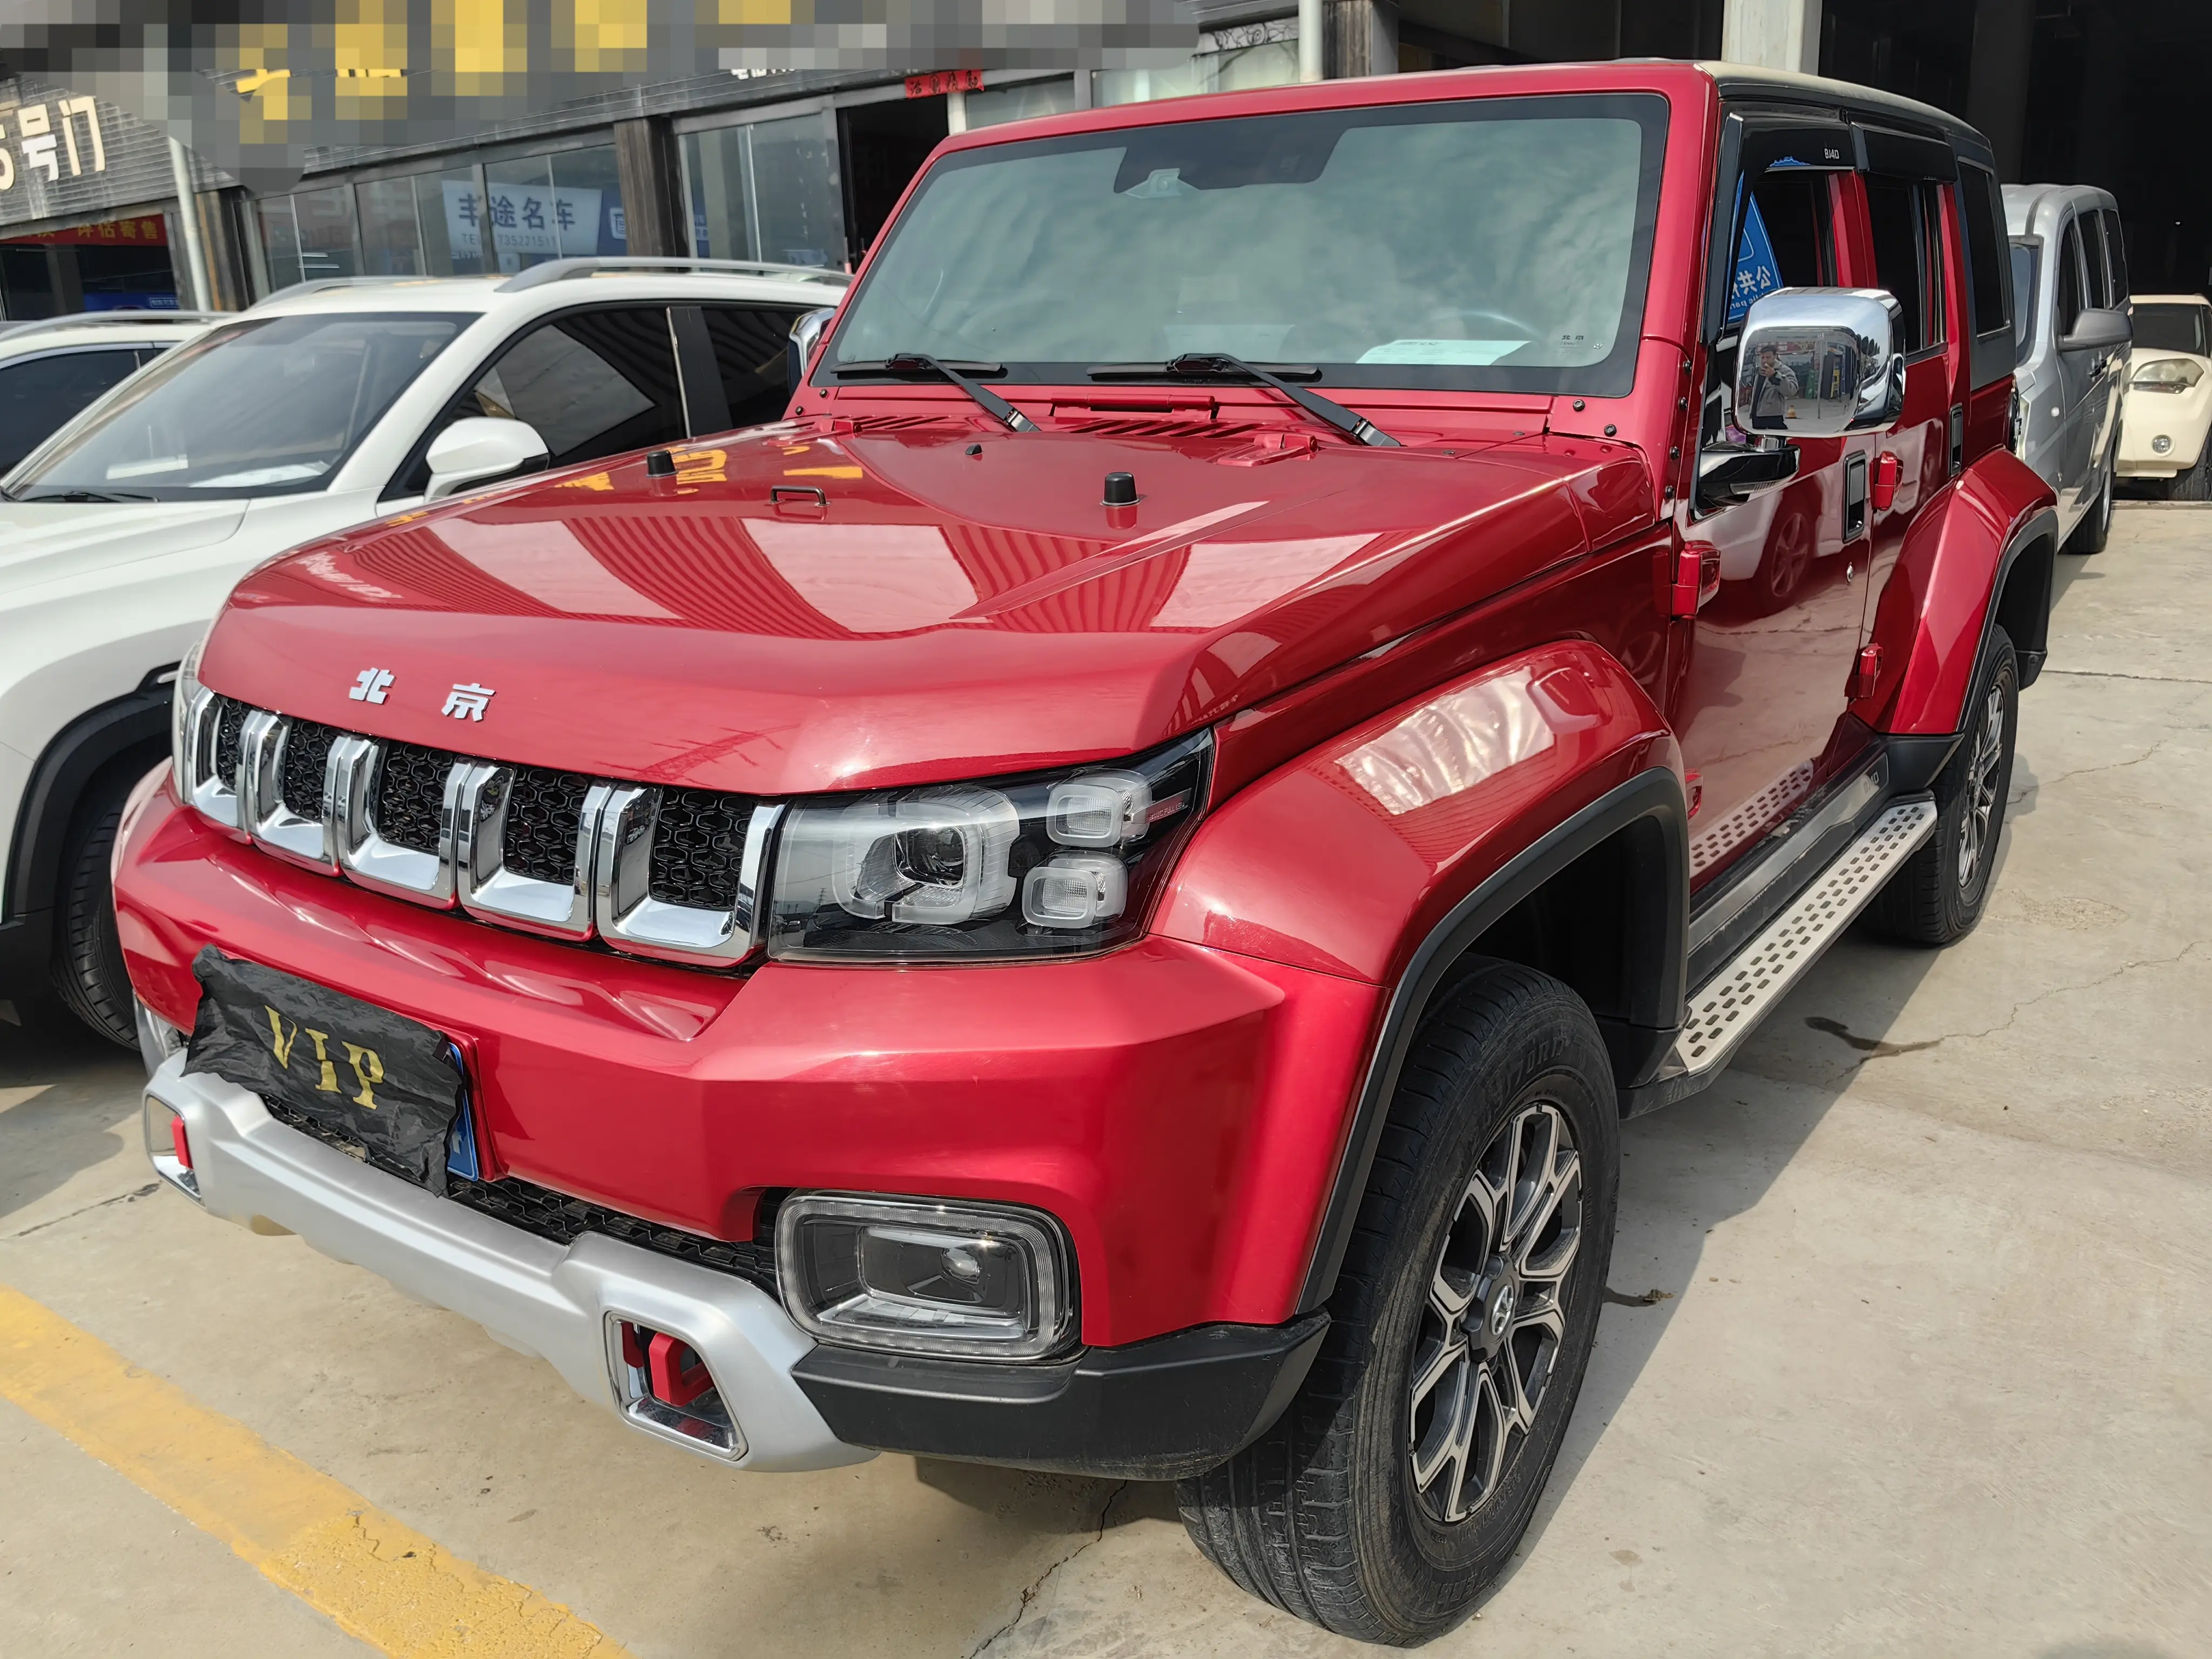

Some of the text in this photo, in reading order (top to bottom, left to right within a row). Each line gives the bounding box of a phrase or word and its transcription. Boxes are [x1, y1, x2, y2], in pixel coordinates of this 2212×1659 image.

[458, 193, 576, 231] 丰途名车
[349, 667, 497, 723] 北京
[264, 1004, 385, 1110] VIP
